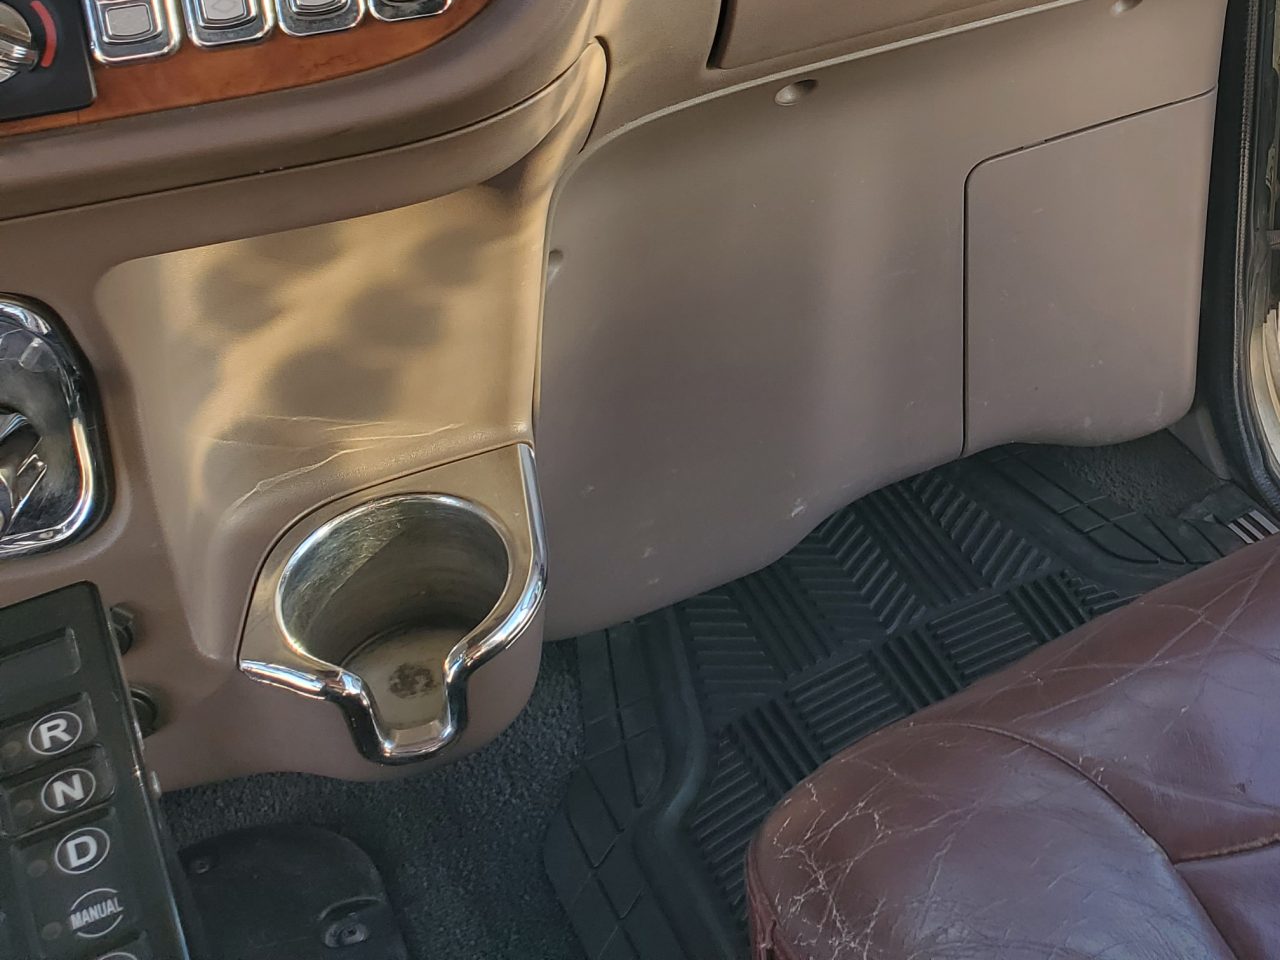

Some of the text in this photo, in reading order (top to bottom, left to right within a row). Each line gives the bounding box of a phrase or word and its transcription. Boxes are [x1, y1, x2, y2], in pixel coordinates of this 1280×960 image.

[38, 718, 73, 750] R
[52, 773, 85, 809] N
[65, 835, 98, 869] D
[70, 897, 124, 931] MANUAL
